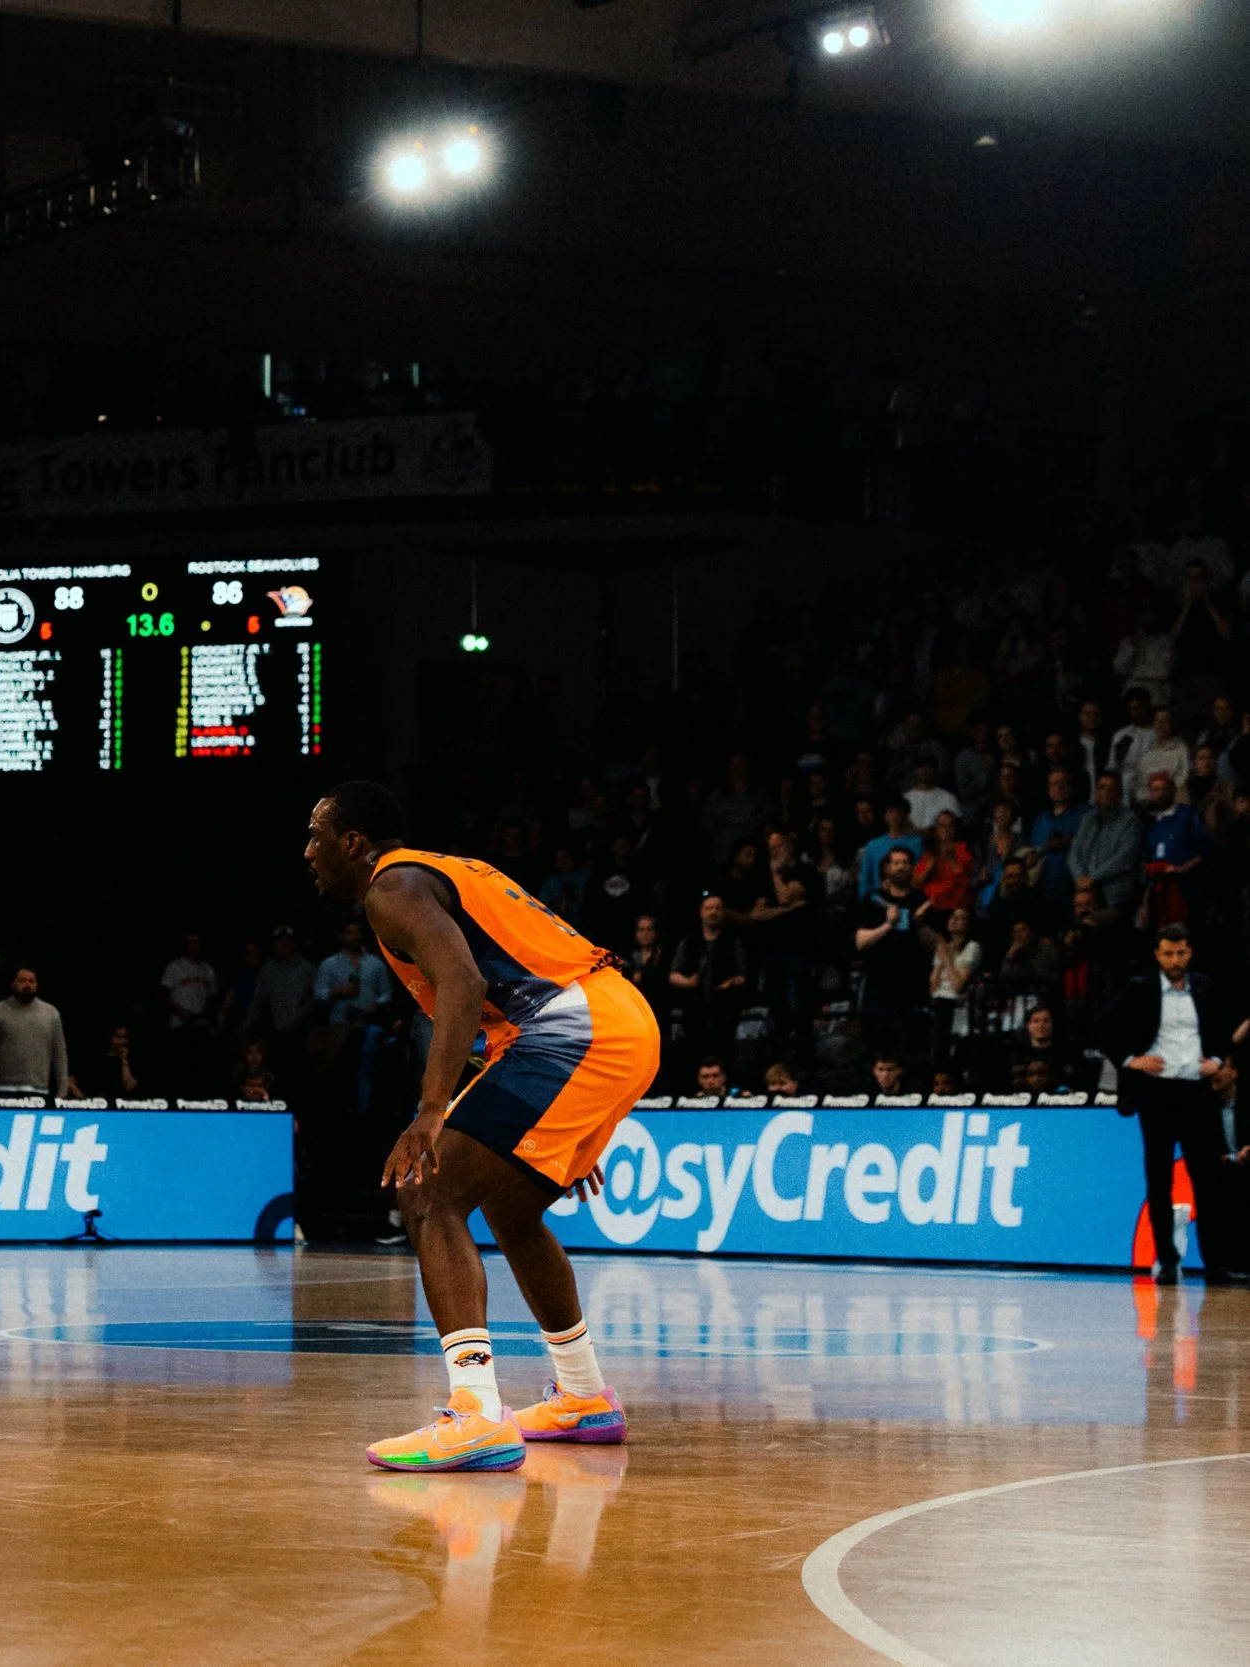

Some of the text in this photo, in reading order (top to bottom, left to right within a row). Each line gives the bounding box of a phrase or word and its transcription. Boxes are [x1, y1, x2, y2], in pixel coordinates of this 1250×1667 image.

[34, 452, 201, 497] Towers
[53, 585, 85, 611] 88
[211, 580, 244, 606] 86
[126, 612, 175, 637] 13.6
